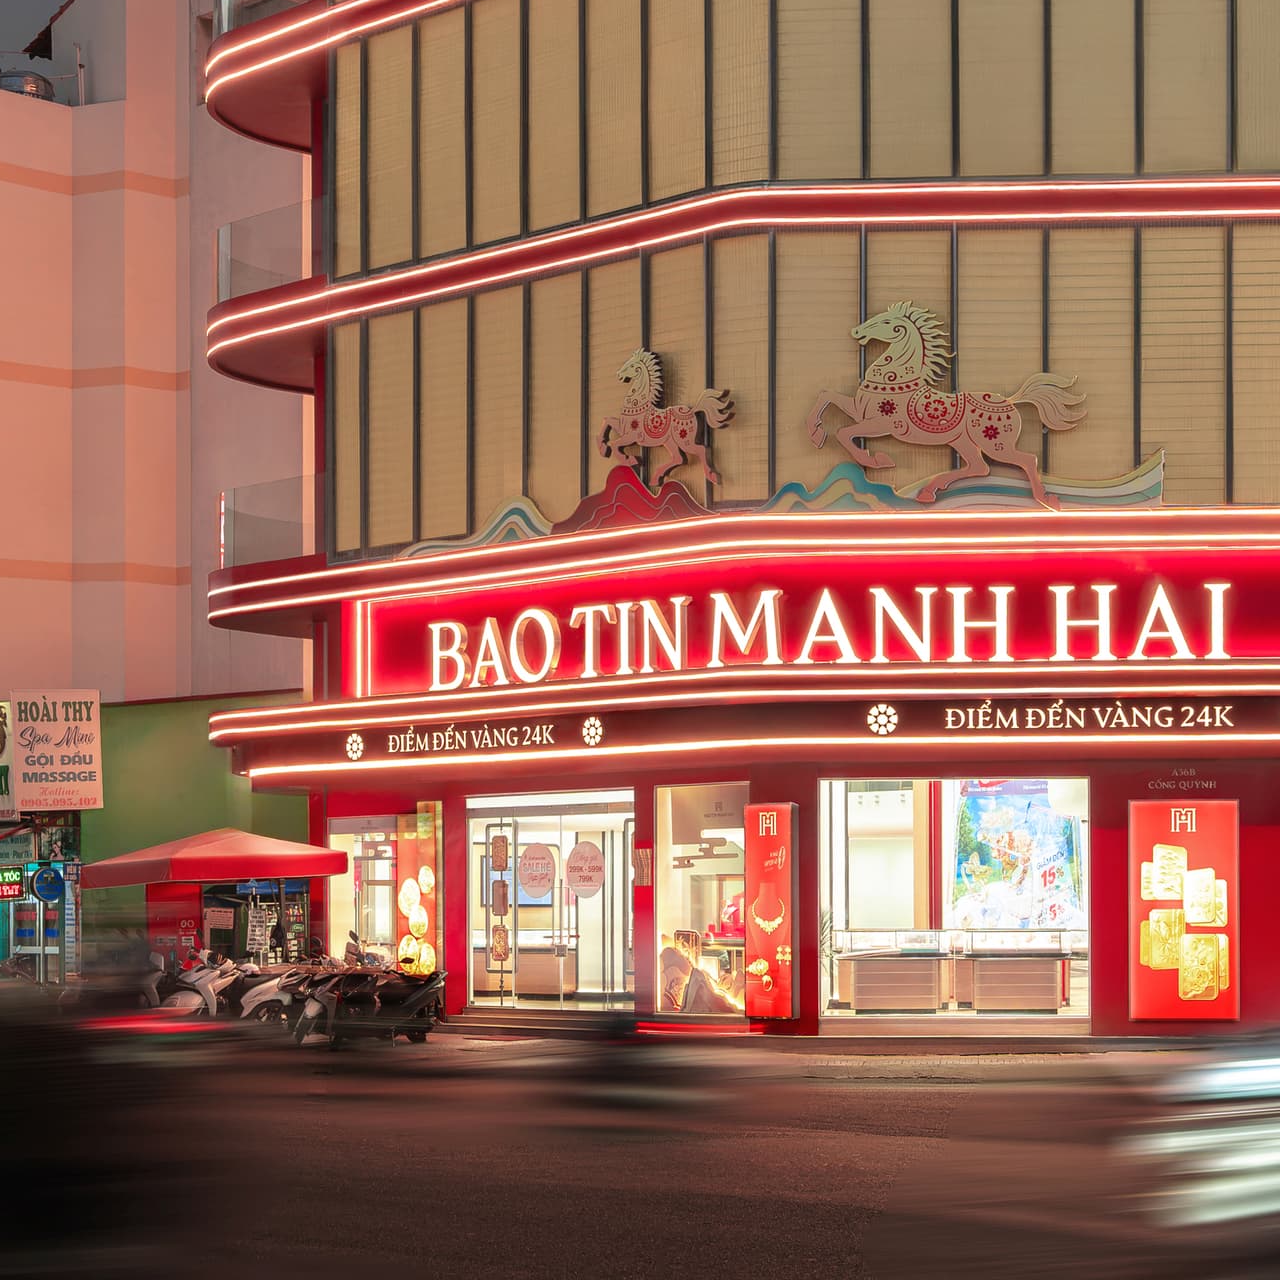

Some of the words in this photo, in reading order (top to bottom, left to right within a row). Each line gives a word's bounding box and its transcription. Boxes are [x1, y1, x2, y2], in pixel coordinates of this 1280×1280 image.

[427, 608, 563, 693] BAO
[568, 595, 693, 680] TIN
[707, 583, 1016, 668] MANH
[1047, 581, 1232, 662] HAI
[17, 695, 58, 722] HOÀI
[61, 701, 94, 722] THY
[945, 699, 1020, 730] ĐIỂM
[1024, 699, 1087, 730] ĐẾN
[1092, 701, 1175, 730] VÀNG
[1179, 703, 1235, 729] 24K
[18, 726, 52, 754] Spa
[432, 724, 468, 751] ĐẾN
[470, 723, 520, 749] VÀNG
[522, 724, 555, 746] 24K
[24, 753, 54, 769] GỘI
[60, 751, 93, 766] ĐẦU
[22, 771, 97, 784] MASSAGE
